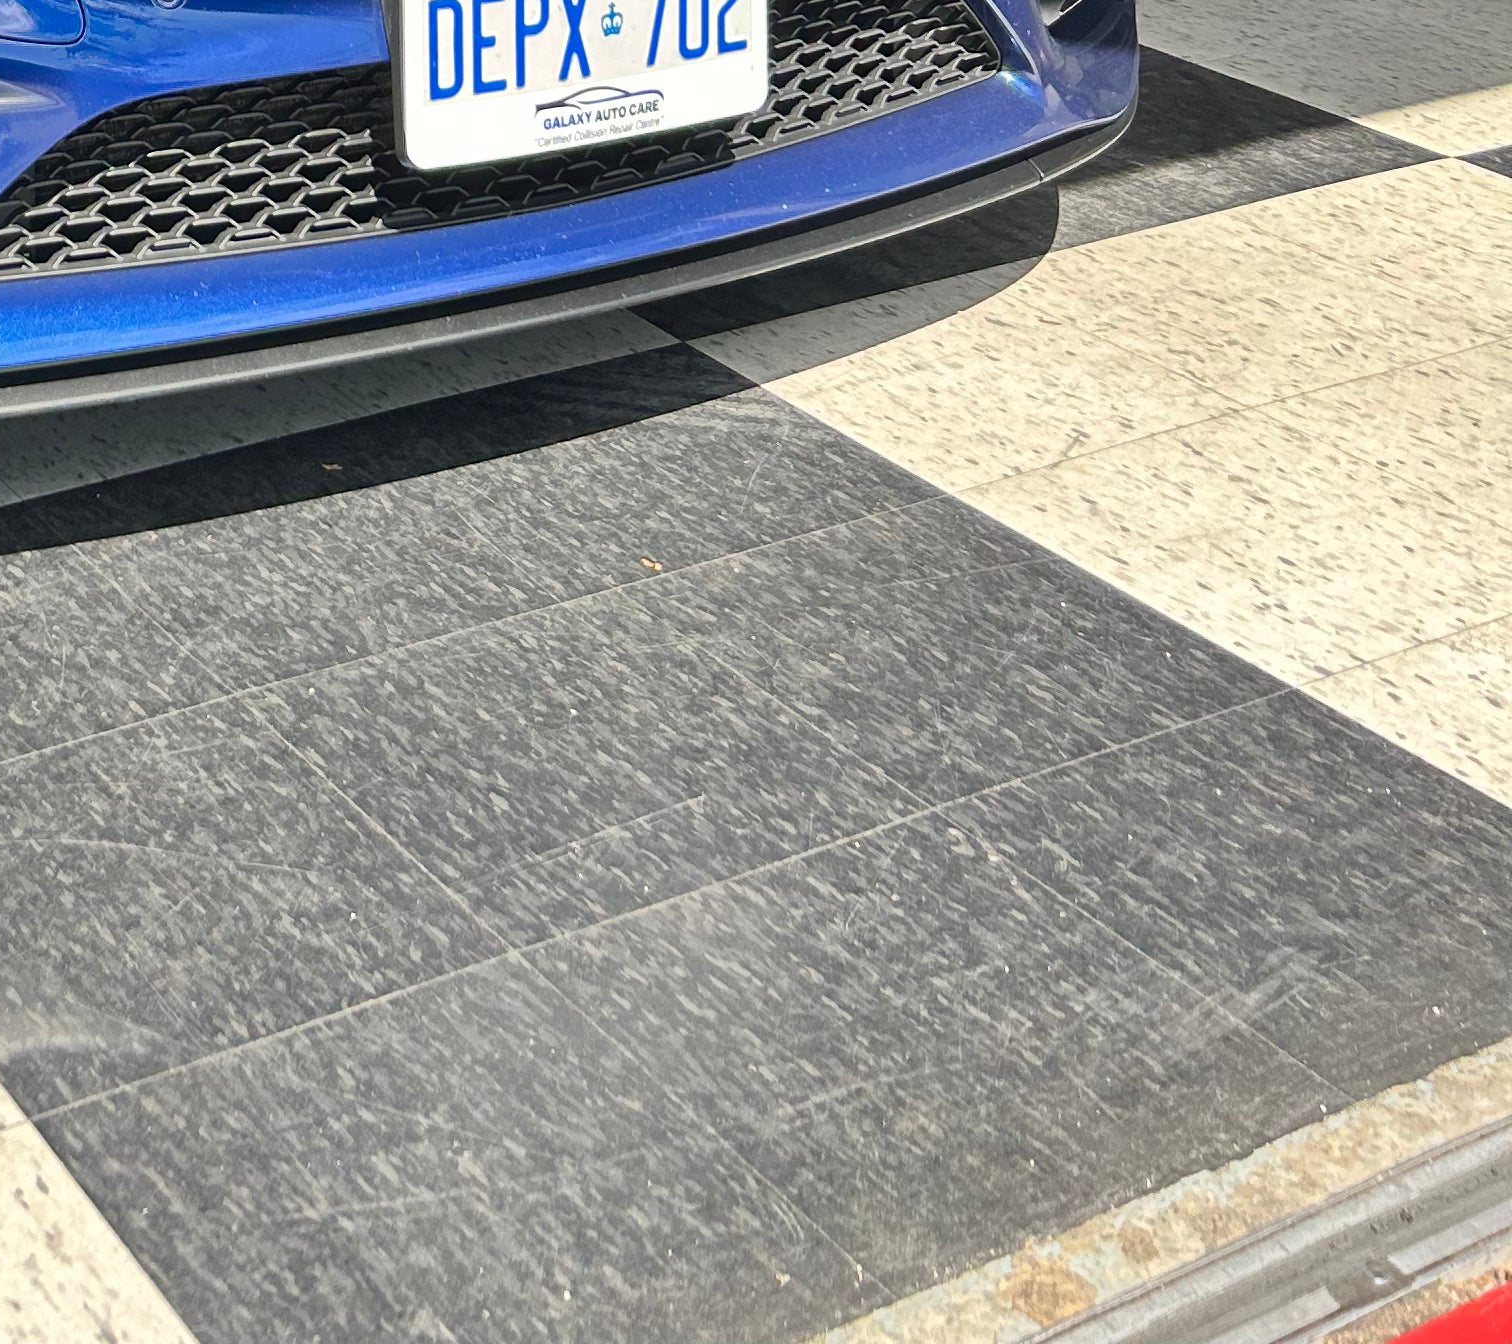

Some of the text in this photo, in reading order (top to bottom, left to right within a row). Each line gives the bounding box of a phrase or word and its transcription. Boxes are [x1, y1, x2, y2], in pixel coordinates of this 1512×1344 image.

[543, 100, 659, 130] GALAXY AUTO CARE
